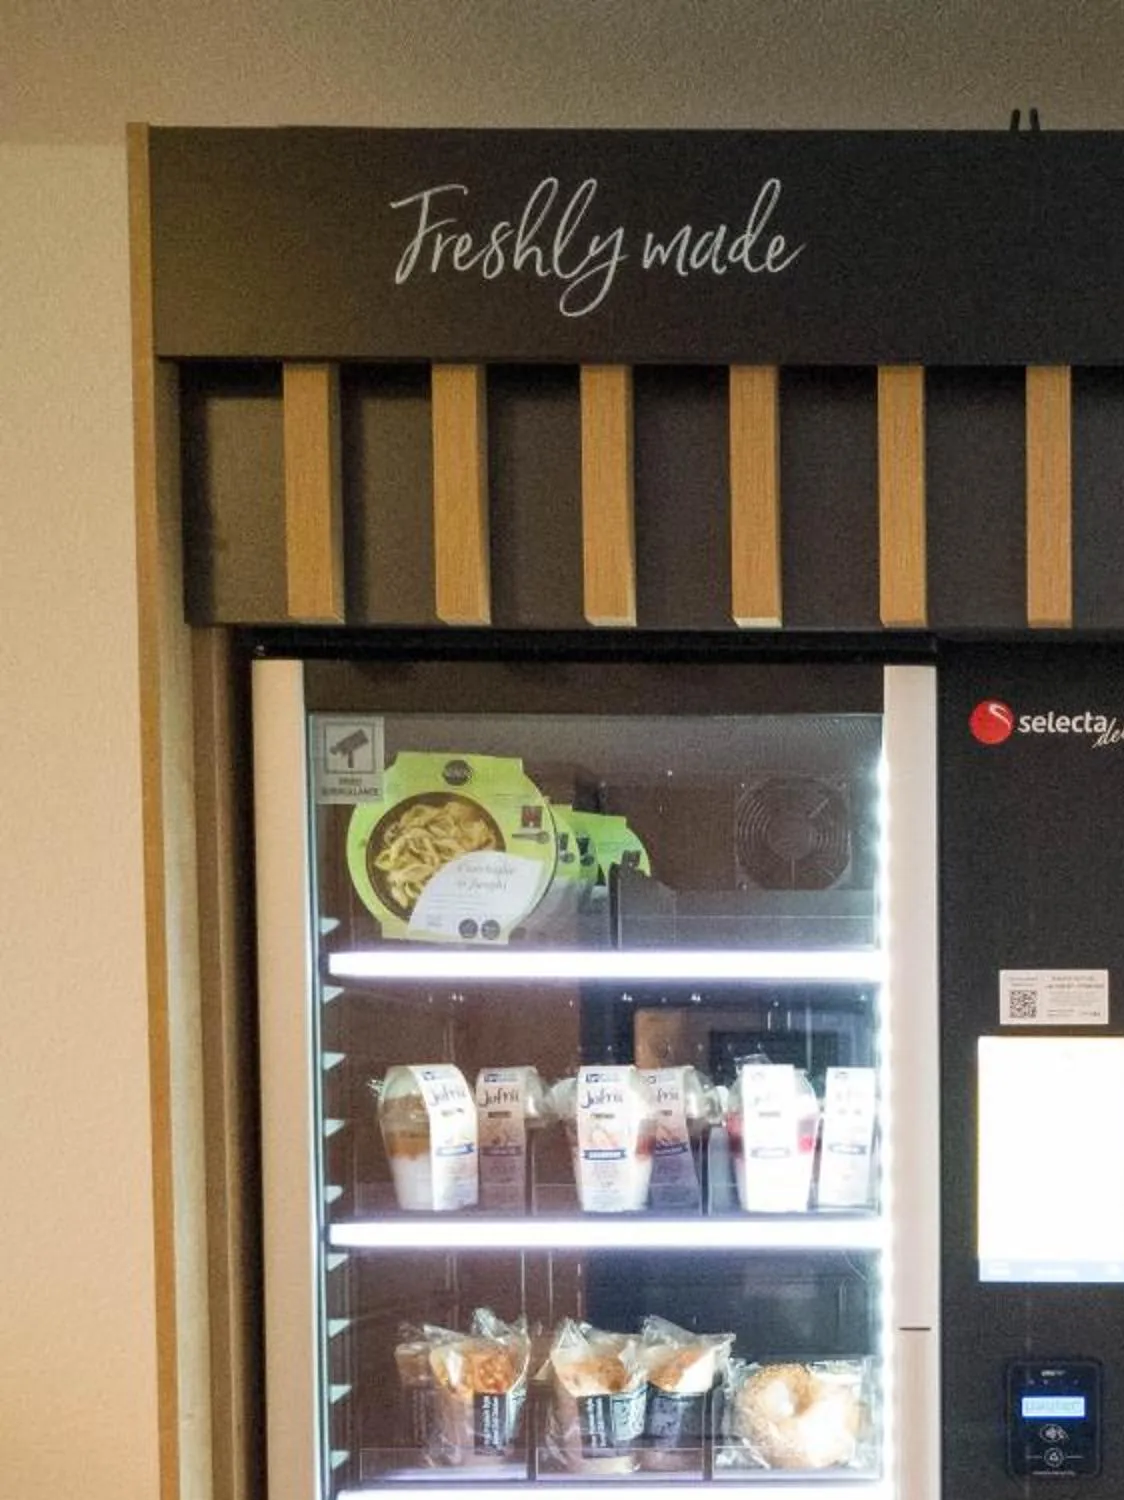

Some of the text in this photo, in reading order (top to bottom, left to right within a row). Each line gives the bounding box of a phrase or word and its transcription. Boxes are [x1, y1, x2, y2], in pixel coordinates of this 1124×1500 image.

[388, 176, 805, 317] Freshly made
[1017, 711, 1107, 734] selecta
